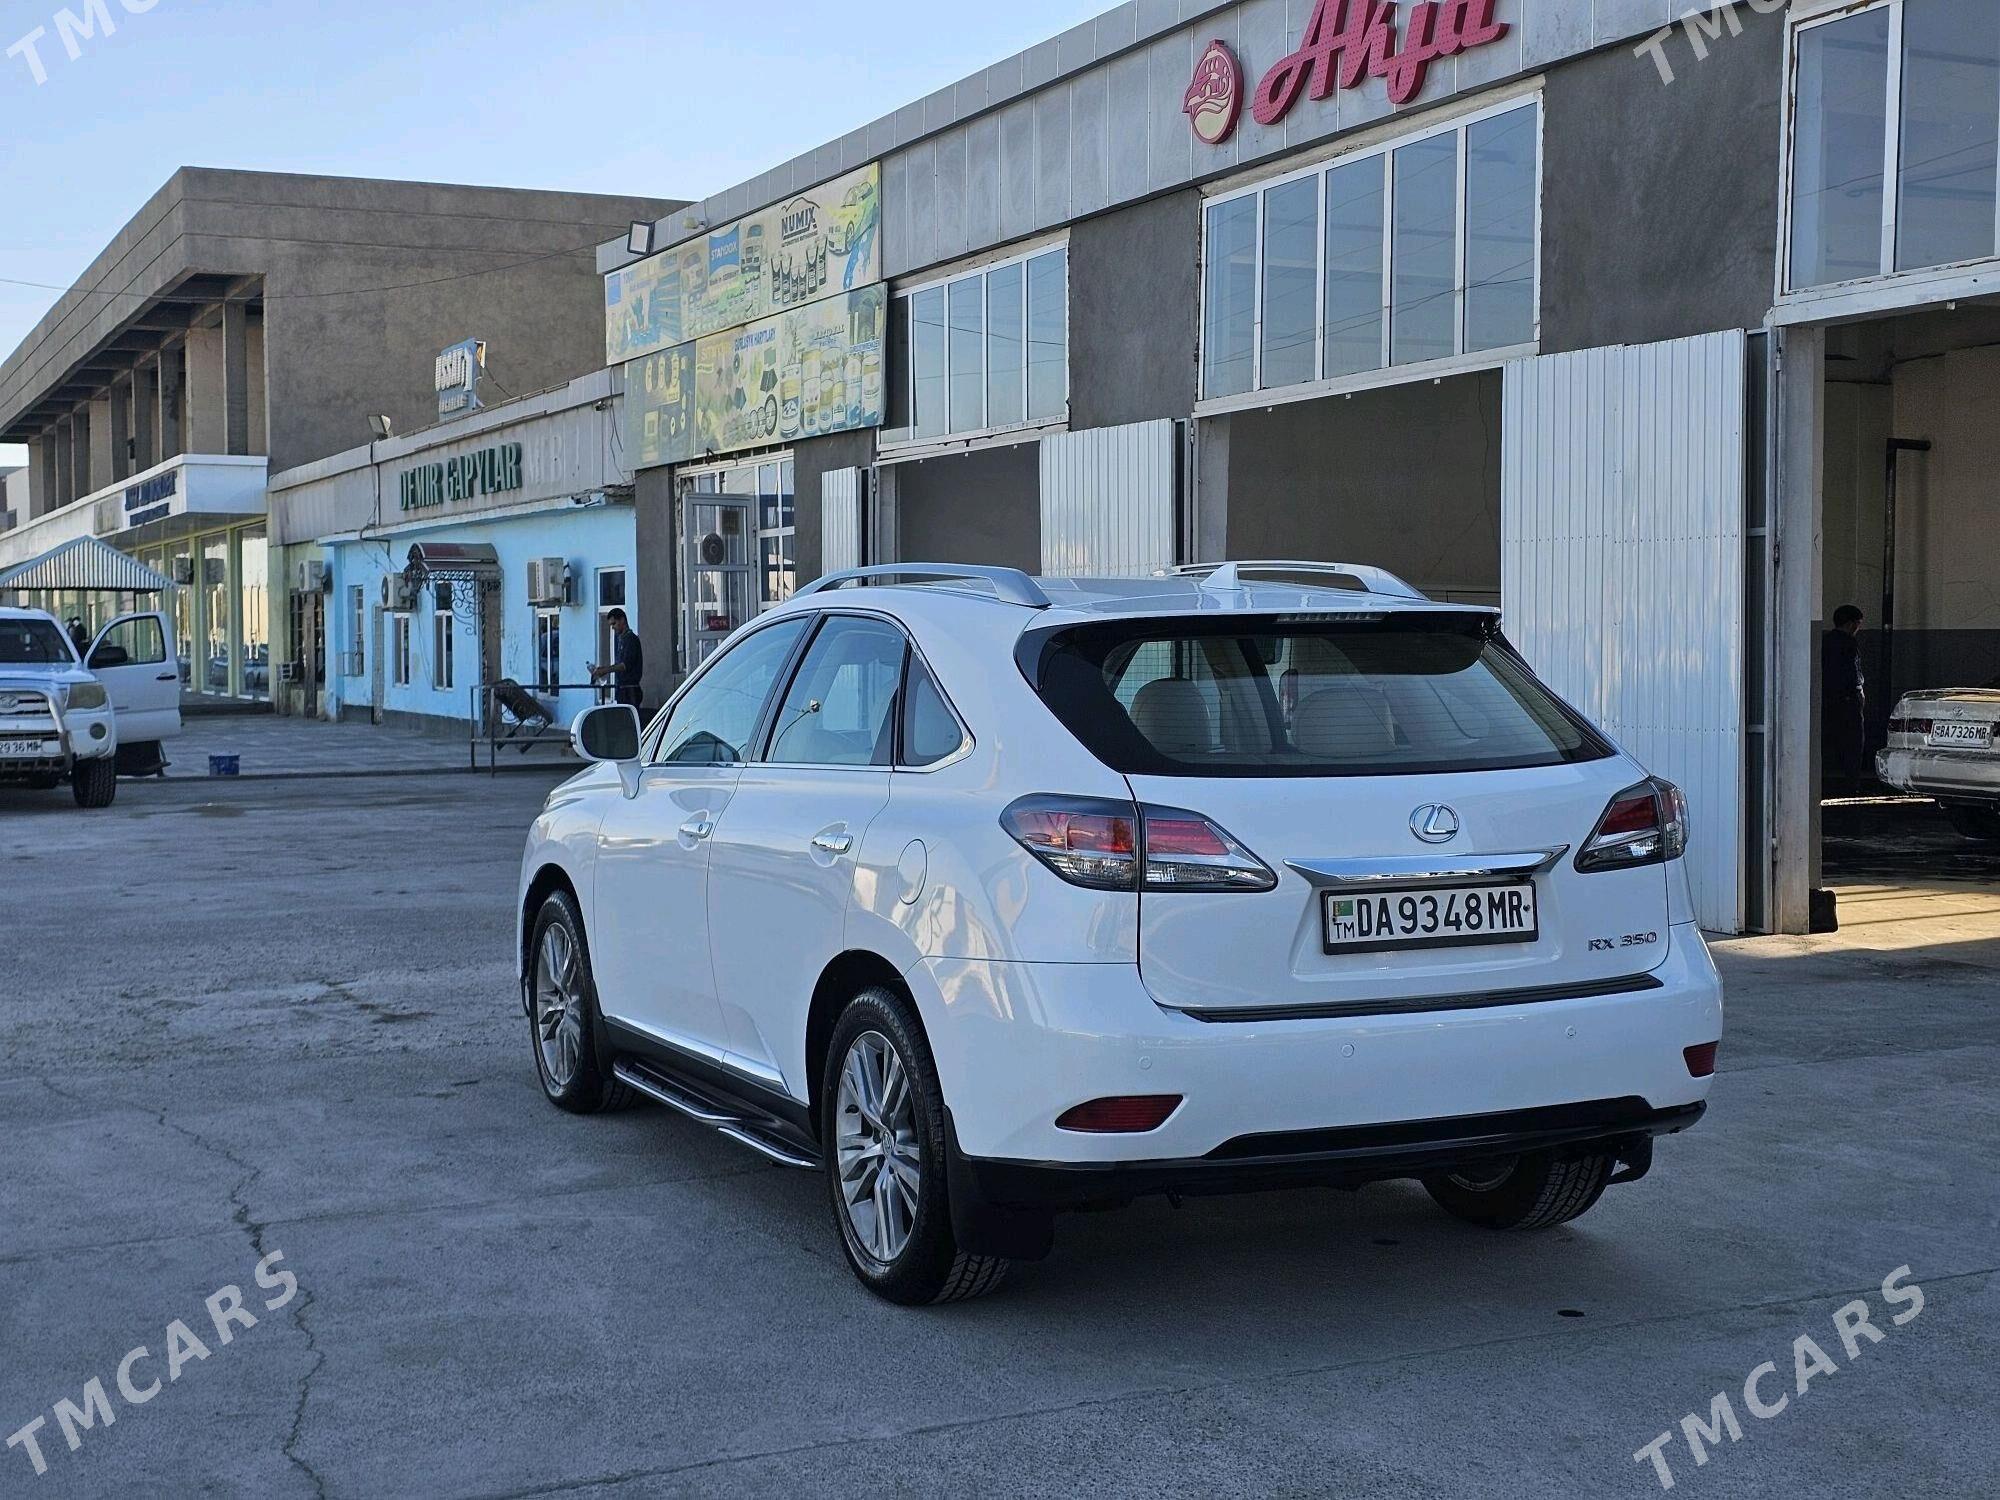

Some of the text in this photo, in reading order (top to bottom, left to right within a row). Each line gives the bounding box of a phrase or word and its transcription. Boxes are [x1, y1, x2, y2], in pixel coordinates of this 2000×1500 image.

[781, 206, 816, 238] NUMIX
[711, 241, 738, 261] STANDOX
[400, 463, 444, 511] DEMIR
[447, 442, 523, 501] GAPYLAR
[1940, 725, 1987, 739] BA7326MR
[1334, 890, 1524, 939] TM DA9348MR
[1588, 931, 1657, 951] RX 350
